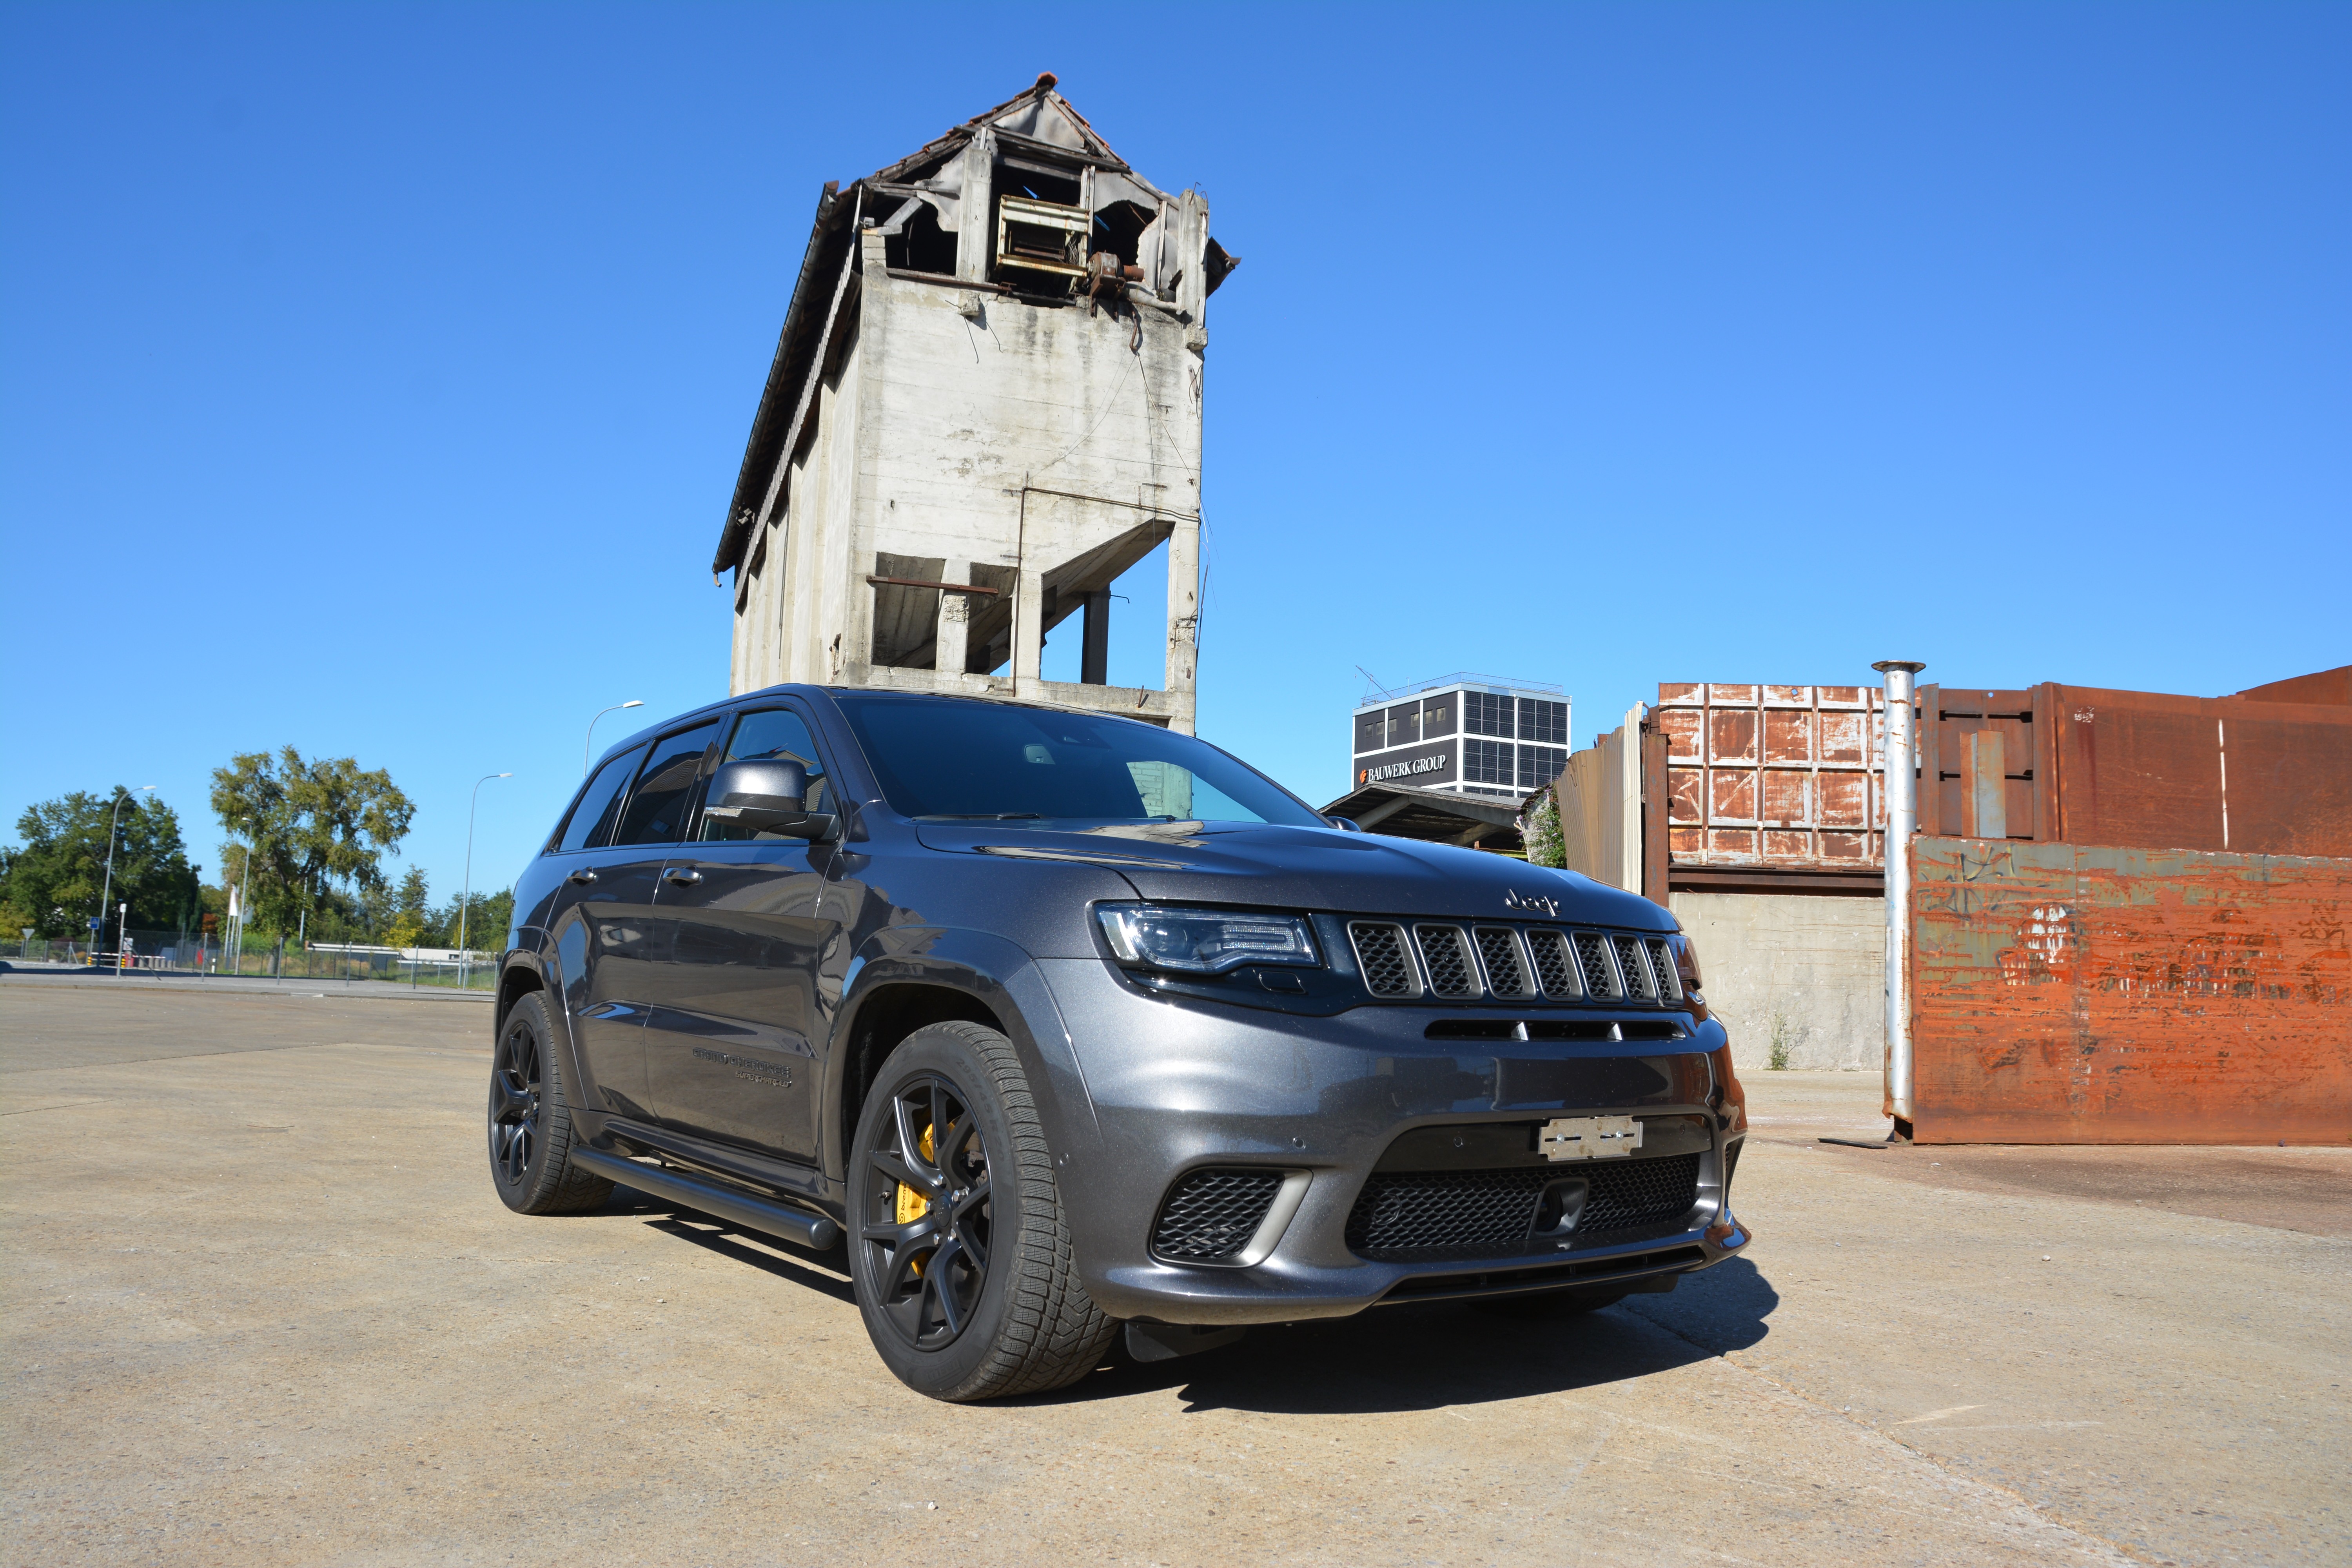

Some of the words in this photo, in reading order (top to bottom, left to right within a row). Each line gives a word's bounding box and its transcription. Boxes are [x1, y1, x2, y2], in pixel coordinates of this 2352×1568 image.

[1368, 761, 1412, 781] BAUWERK
[1413, 755, 1446, 773] GROUP
[1504, 888, 1562, 918] Jeep
[693, 1047, 728, 1064] GRAND
[729, 1056, 791, 1078] CHEROKEE
[735, 1071, 792, 1088] SUPERCHARGED
